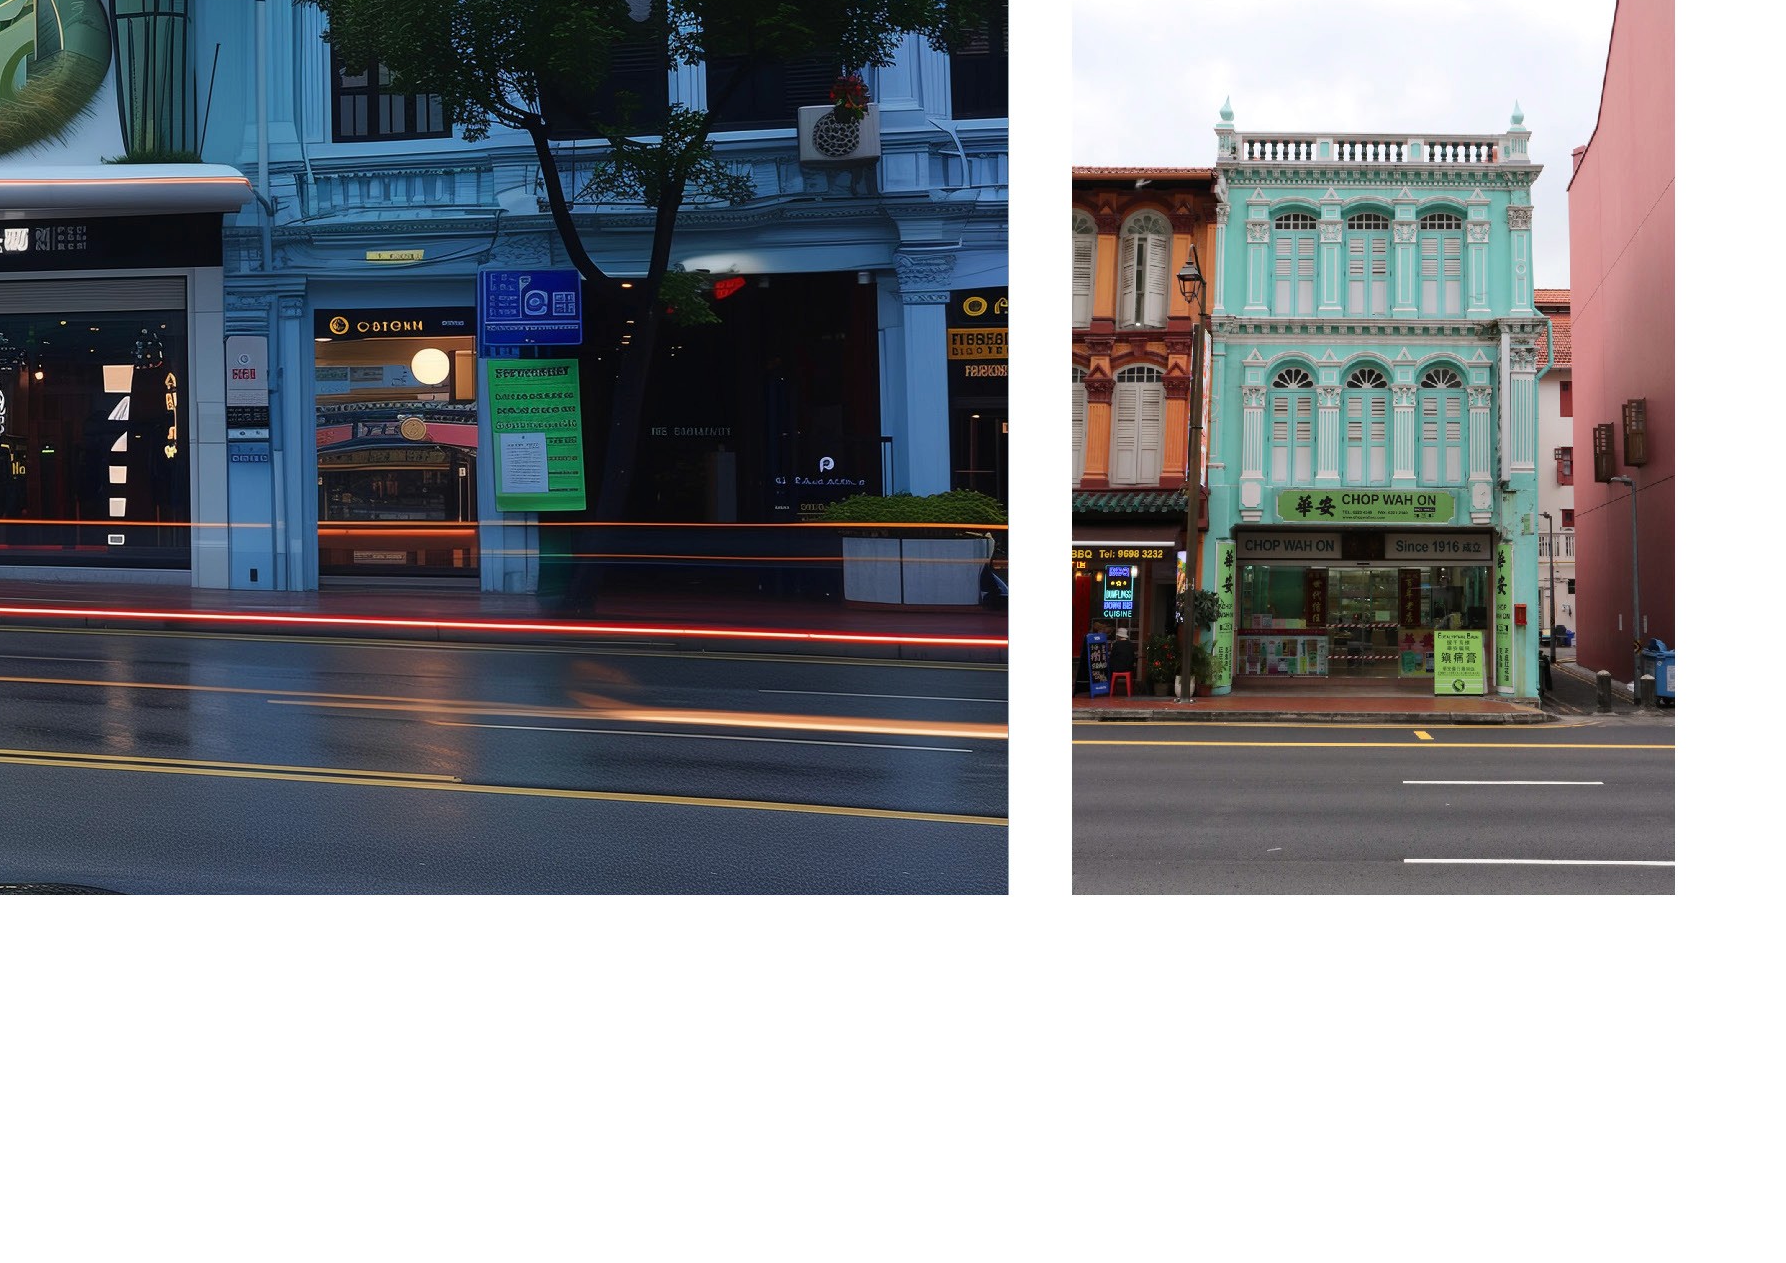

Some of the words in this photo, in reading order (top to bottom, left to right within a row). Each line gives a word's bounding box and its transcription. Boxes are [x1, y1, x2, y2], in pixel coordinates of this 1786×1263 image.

[1295, 494, 1336, 517] 華安
[1341, 494, 1380, 506] CHOP
[1382, 494, 1413, 506] WAH
[1417, 494, 1437, 506] ON
[1245, 540, 1281, 552] CHOP
[1283, 540, 1312, 552] WAH
[1315, 540, 1335, 552] ON
[1395, 540, 1429, 552] Since
[1431, 540, 1459, 552] 1916
[1099, 550, 1115, 559] Tel:
[1117, 549, 1140, 558] 9698
[1142, 549, 1164, 559] 3232
[1103, 610, 1133, 618] CUISINE
